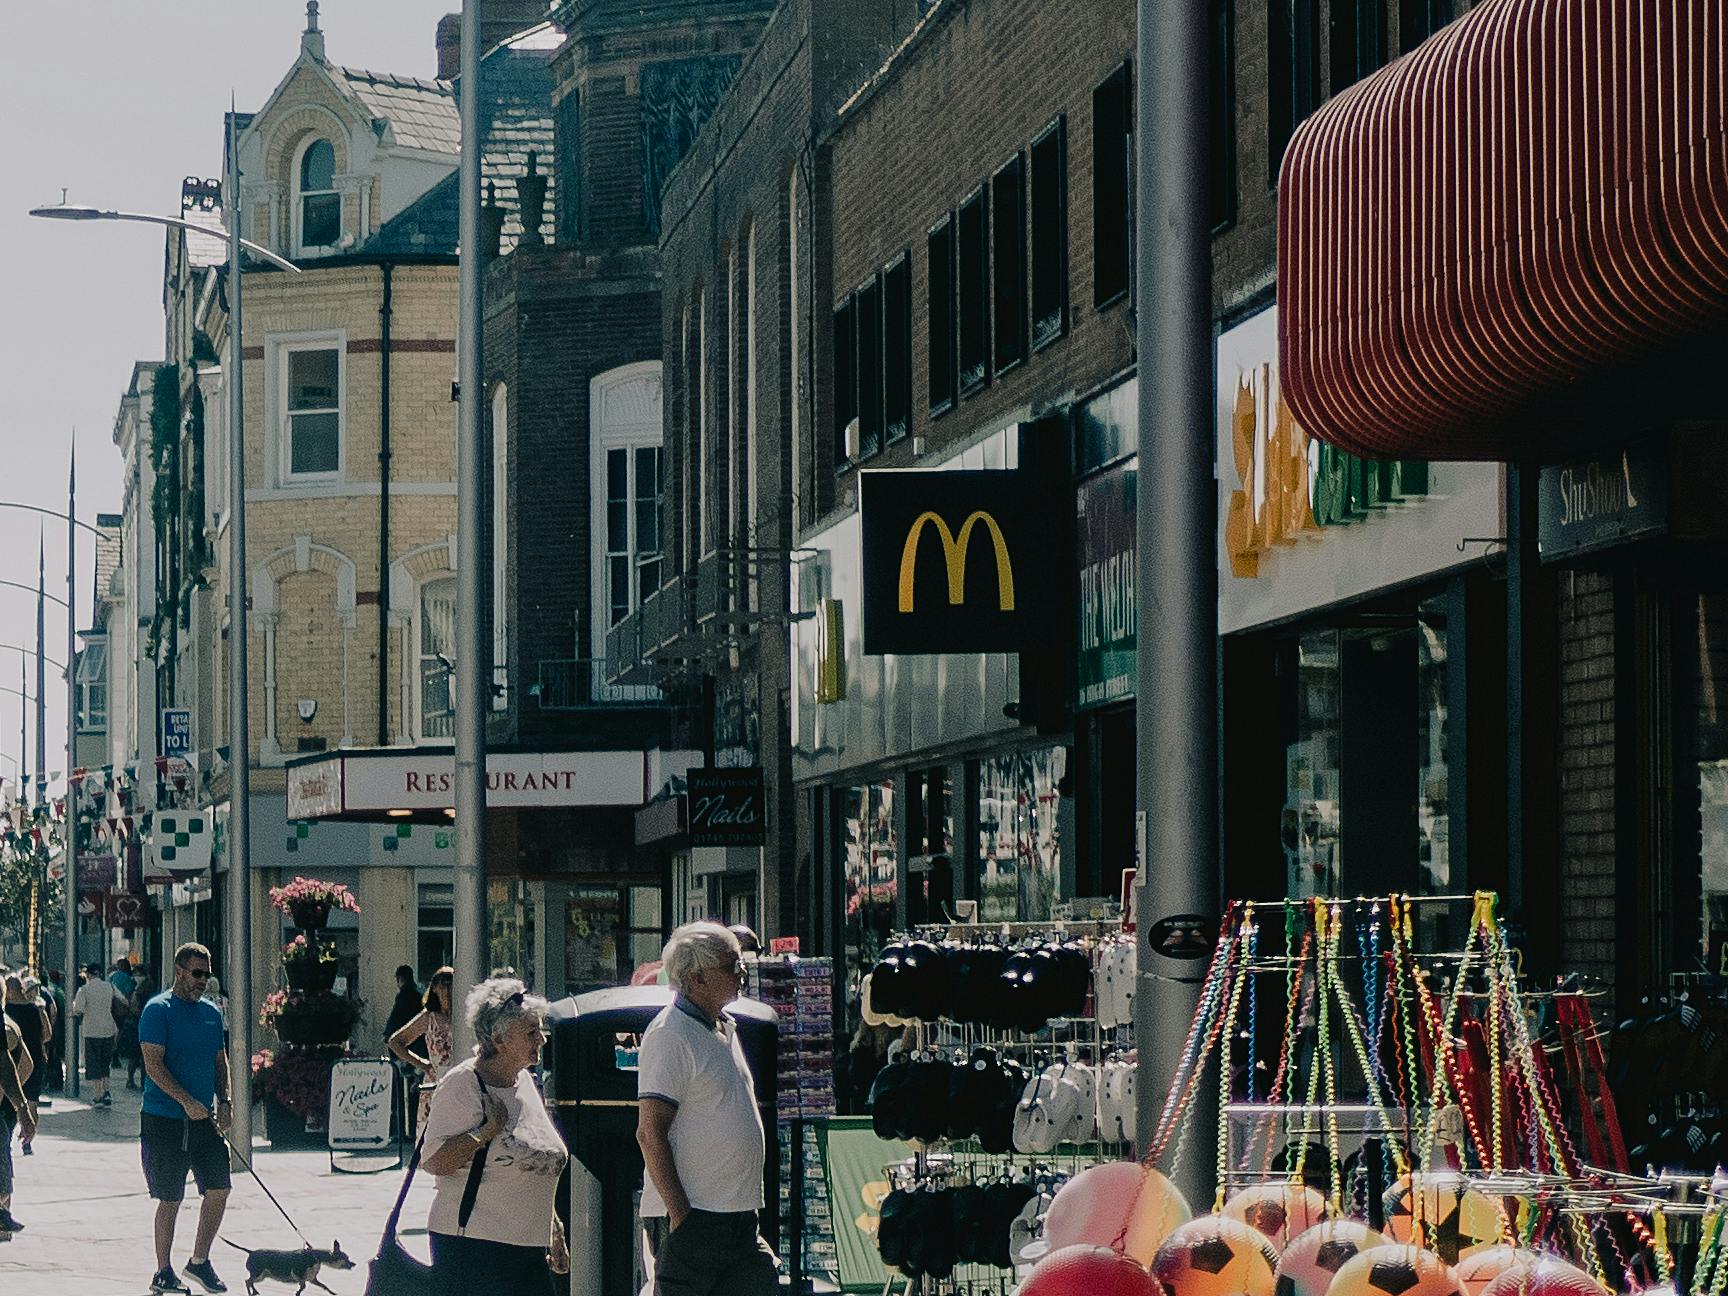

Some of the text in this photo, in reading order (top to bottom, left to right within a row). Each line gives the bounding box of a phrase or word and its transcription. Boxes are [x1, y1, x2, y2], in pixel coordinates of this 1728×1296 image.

[166, 735, 180, 748] TO
[405, 770, 577, 794] RESURANT
[693, 795, 759, 828] Nails
[336, 1077, 389, 1107] Nails
